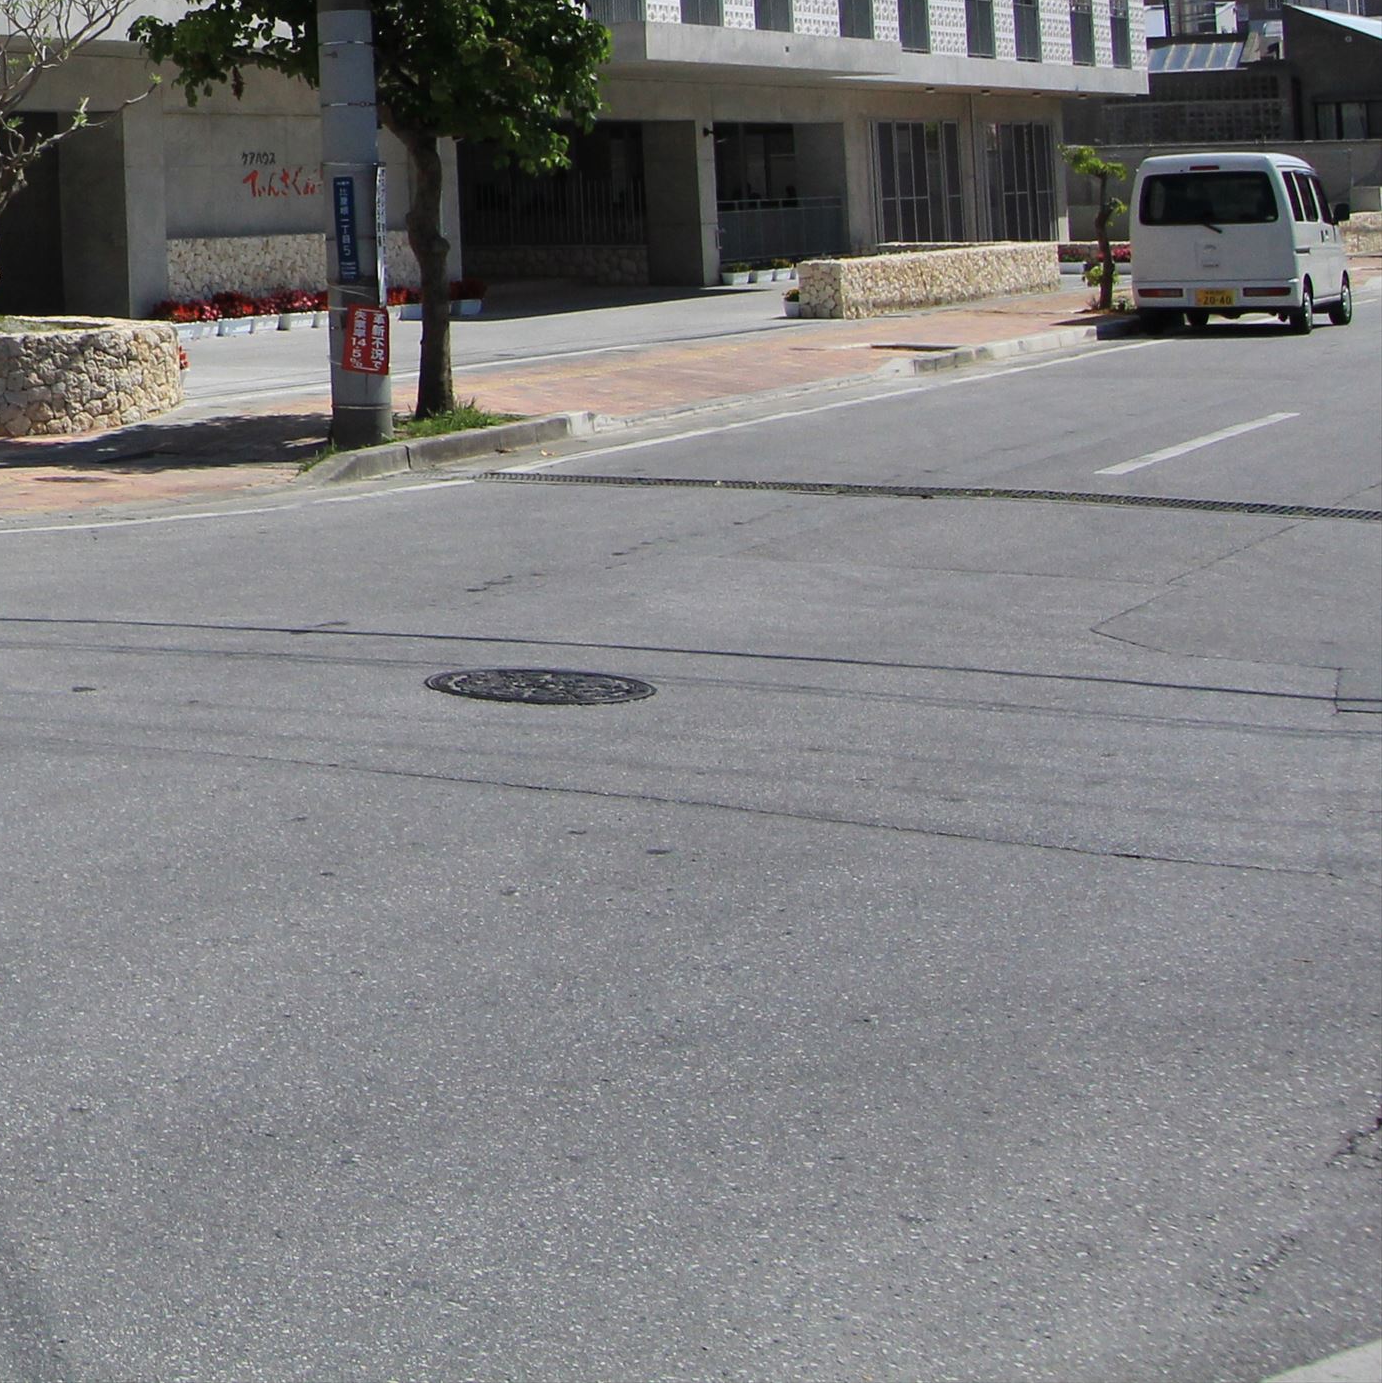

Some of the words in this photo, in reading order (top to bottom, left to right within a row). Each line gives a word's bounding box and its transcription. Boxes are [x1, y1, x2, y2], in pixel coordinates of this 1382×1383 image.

[242, 152, 276, 165] ケアハウス
[370, 313, 386, 369] 革新不況で
